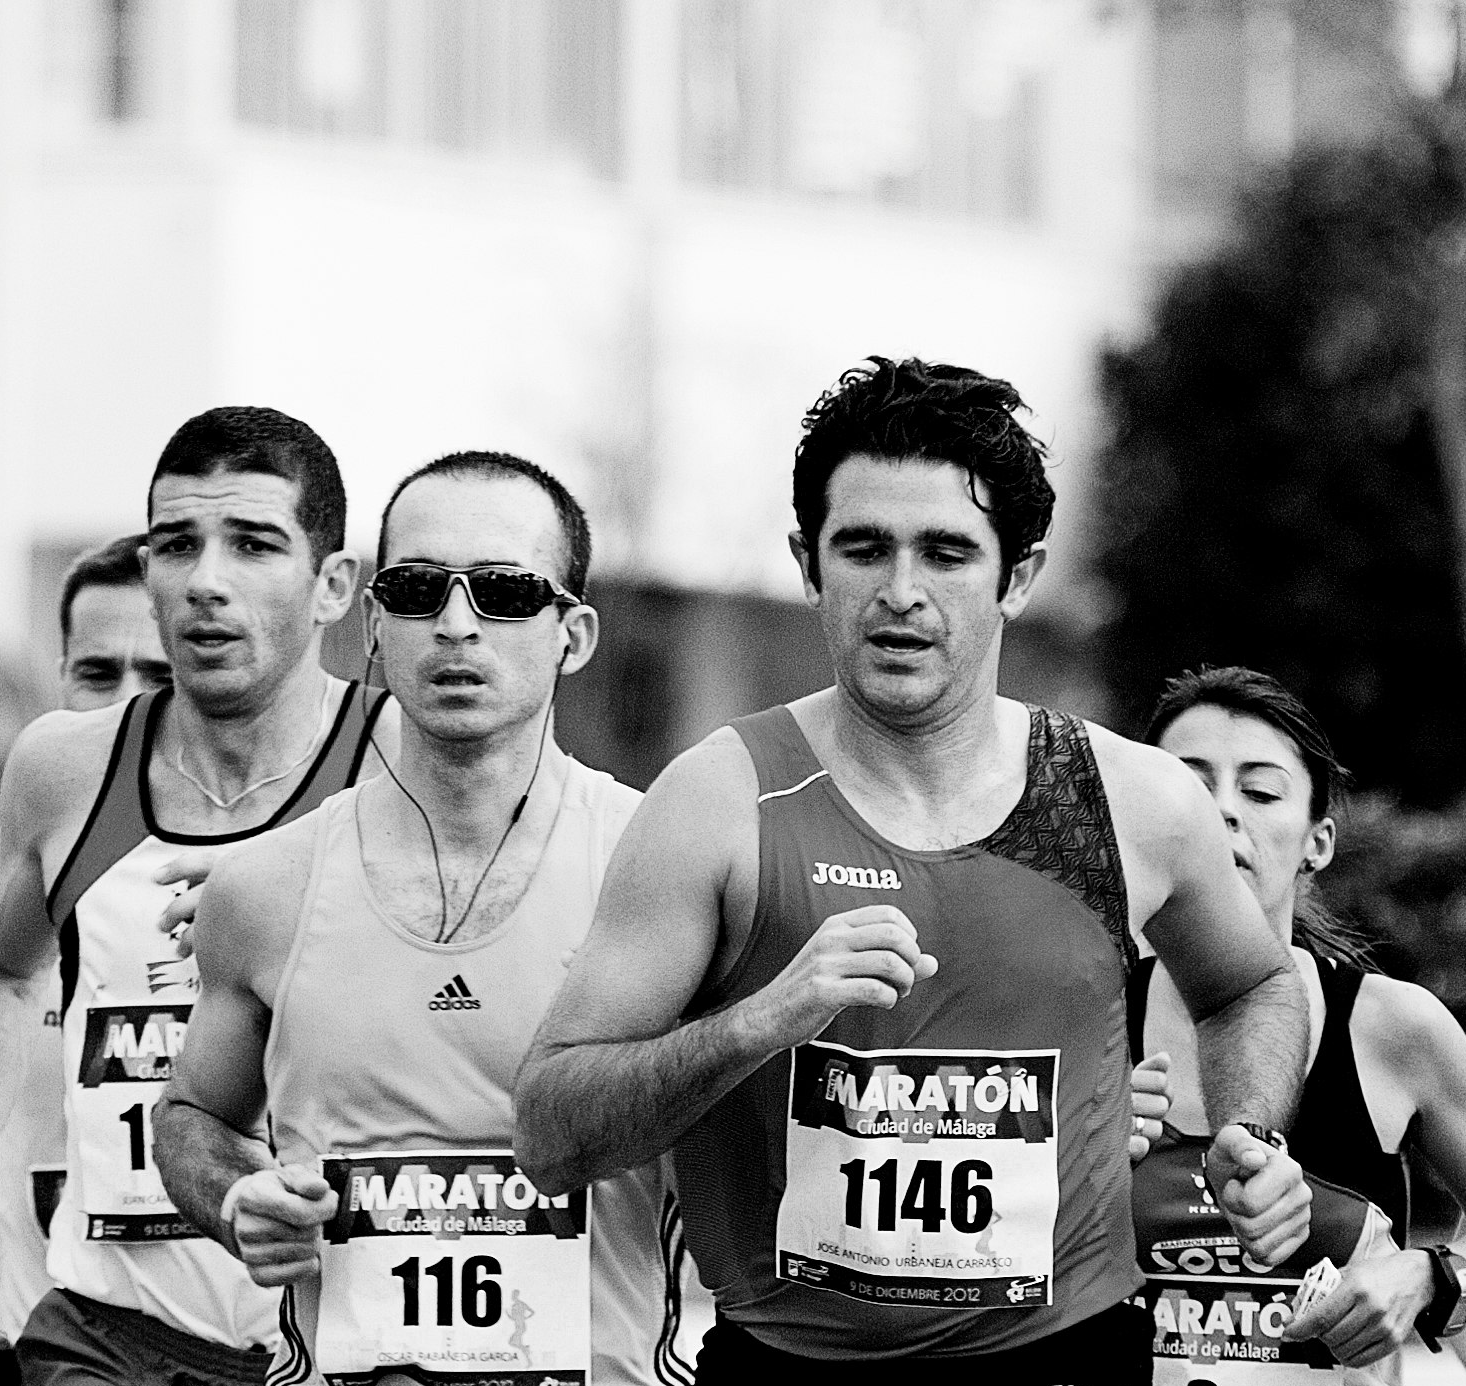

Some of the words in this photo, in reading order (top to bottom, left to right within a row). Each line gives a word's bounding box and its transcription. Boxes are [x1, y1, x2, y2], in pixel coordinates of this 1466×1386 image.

[812, 861, 903, 890] Joma
[428, 998, 482, 1011] adidas
[826, 1064, 1039, 1113] MARATÓN
[856, 1117, 910, 1135] Ciudad
[912, 1117, 934, 1134] de
[936, 1117, 997, 1138] Málaga
[839, 1157, 994, 1234] 1146
[1188, 1205, 1221, 1214] KEL
[385, 1216, 441, 1233] Ciudad
[443, 1216, 466, 1233] de
[467, 1215, 527, 1235] Málaga
[816, 1241, 841, 1257] JOSÉ
[842, 1249, 891, 1267] ANTONIO
[895, 1256, 953, 1269] URBANEJA
[956, 1256, 1013, 1269] CARRASCO
[391, 1254, 503, 1328] 116
[849, 1280, 857, 1291] 9
[858, 1283, 874, 1296] DE
[875, 1285, 941, 1301] DICIEMBRE
[943, 1287, 981, 1302] 2012
[1134, 1291, 1295, 1339] ARATÓ
[1153, 1339, 1198, 1357] Ciudad
[1200, 1340, 1222, 1357] de
[1224, 1341, 1280, 1362] Málaga
